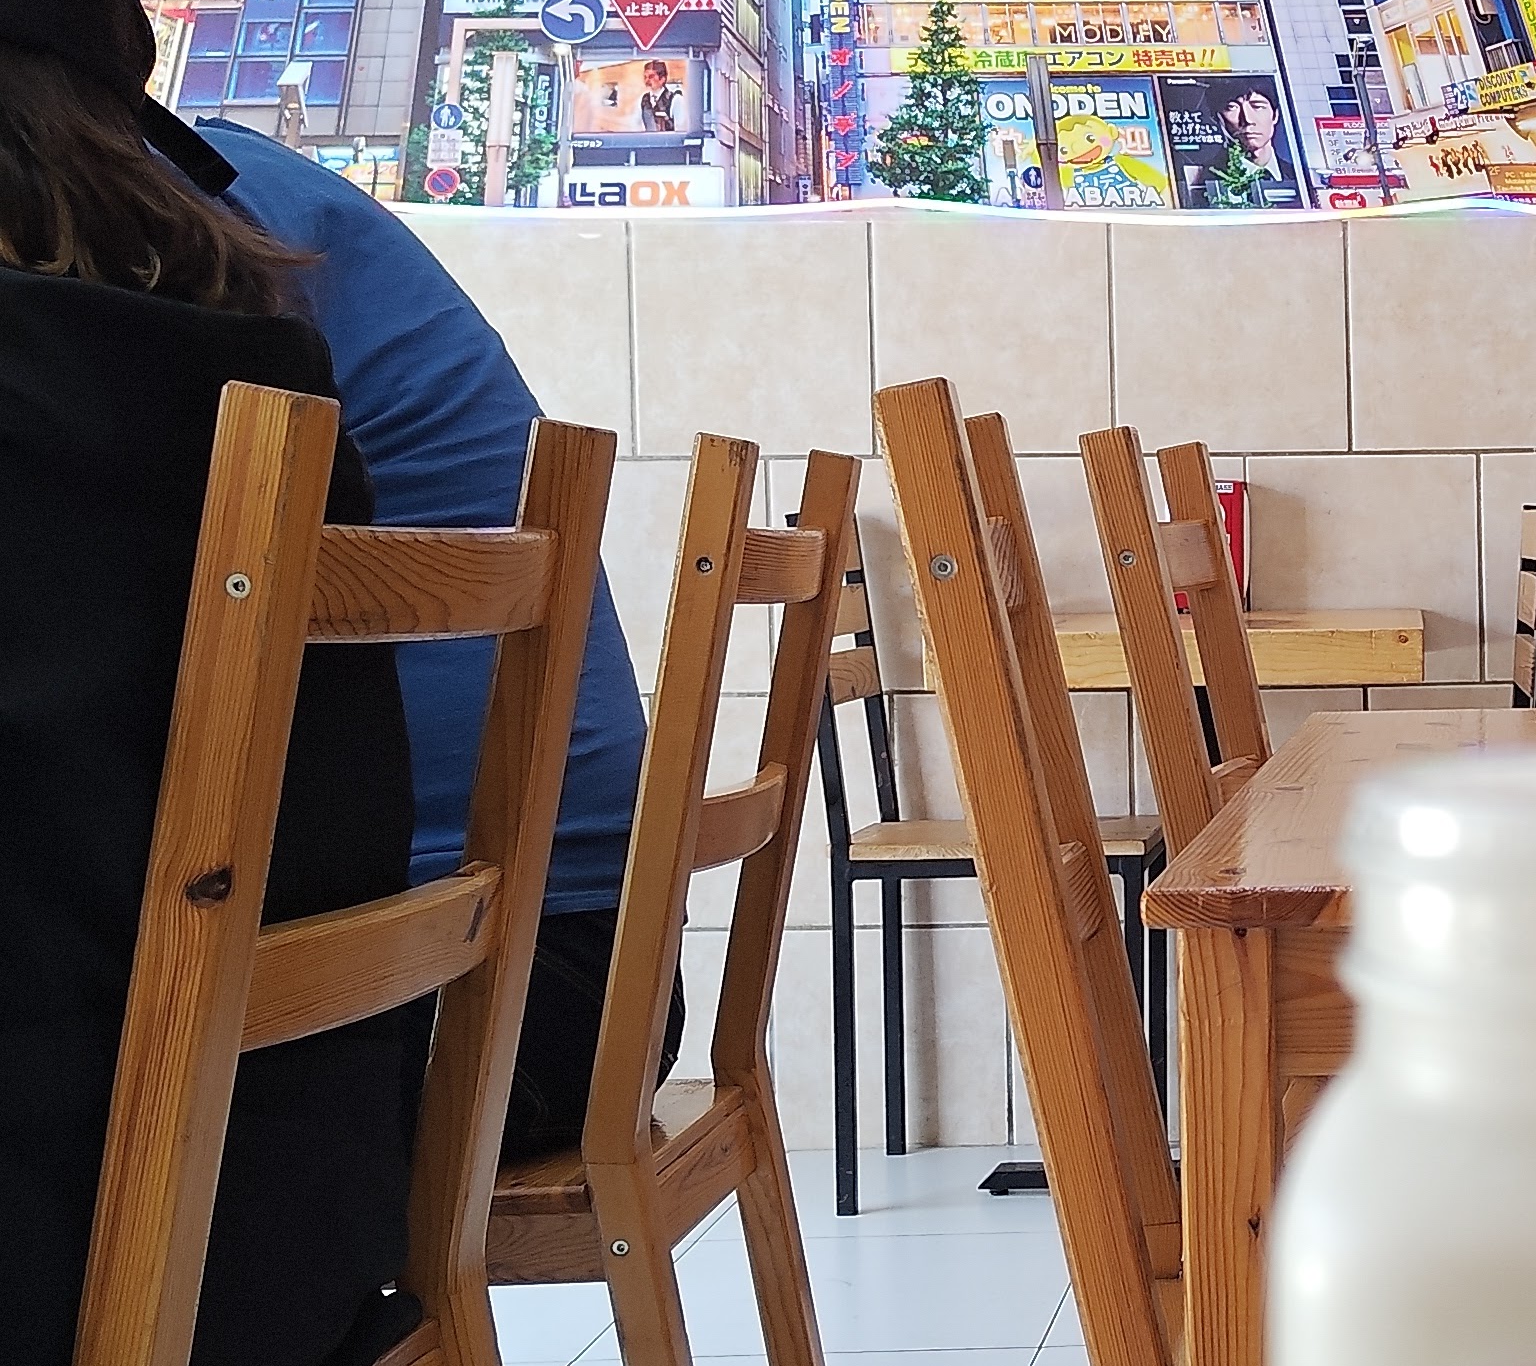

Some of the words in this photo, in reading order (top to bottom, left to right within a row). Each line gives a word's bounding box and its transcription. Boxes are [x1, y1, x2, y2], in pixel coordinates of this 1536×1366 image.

[625, 1, 671, 17] 止まれ
[1046, 52, 1126, 68] エアコン
[1133, 50, 1217, 68] 特売中!!
[1479, 70, 1519, 92] DISCOUNT
[1480, 84, 1530, 107] COMPUTERS
